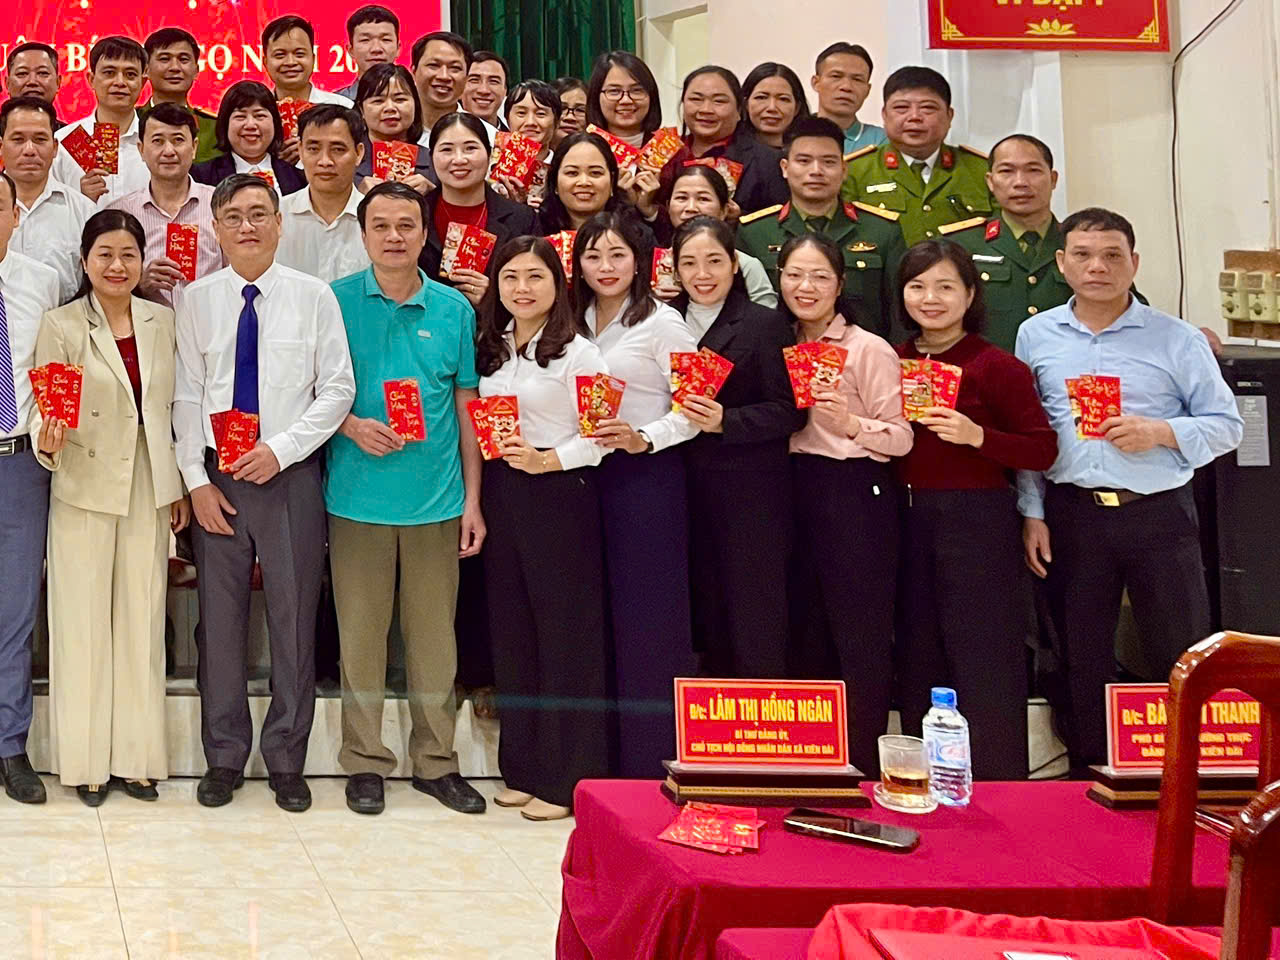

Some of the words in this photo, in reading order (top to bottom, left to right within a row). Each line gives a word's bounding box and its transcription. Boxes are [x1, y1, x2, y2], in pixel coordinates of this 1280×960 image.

[709, 693, 736, 720] LÂM
[738, 698, 759, 726] THỊ
[761, 691, 795, 722] HỒNG
[797, 695, 833, 722] NGÂN
